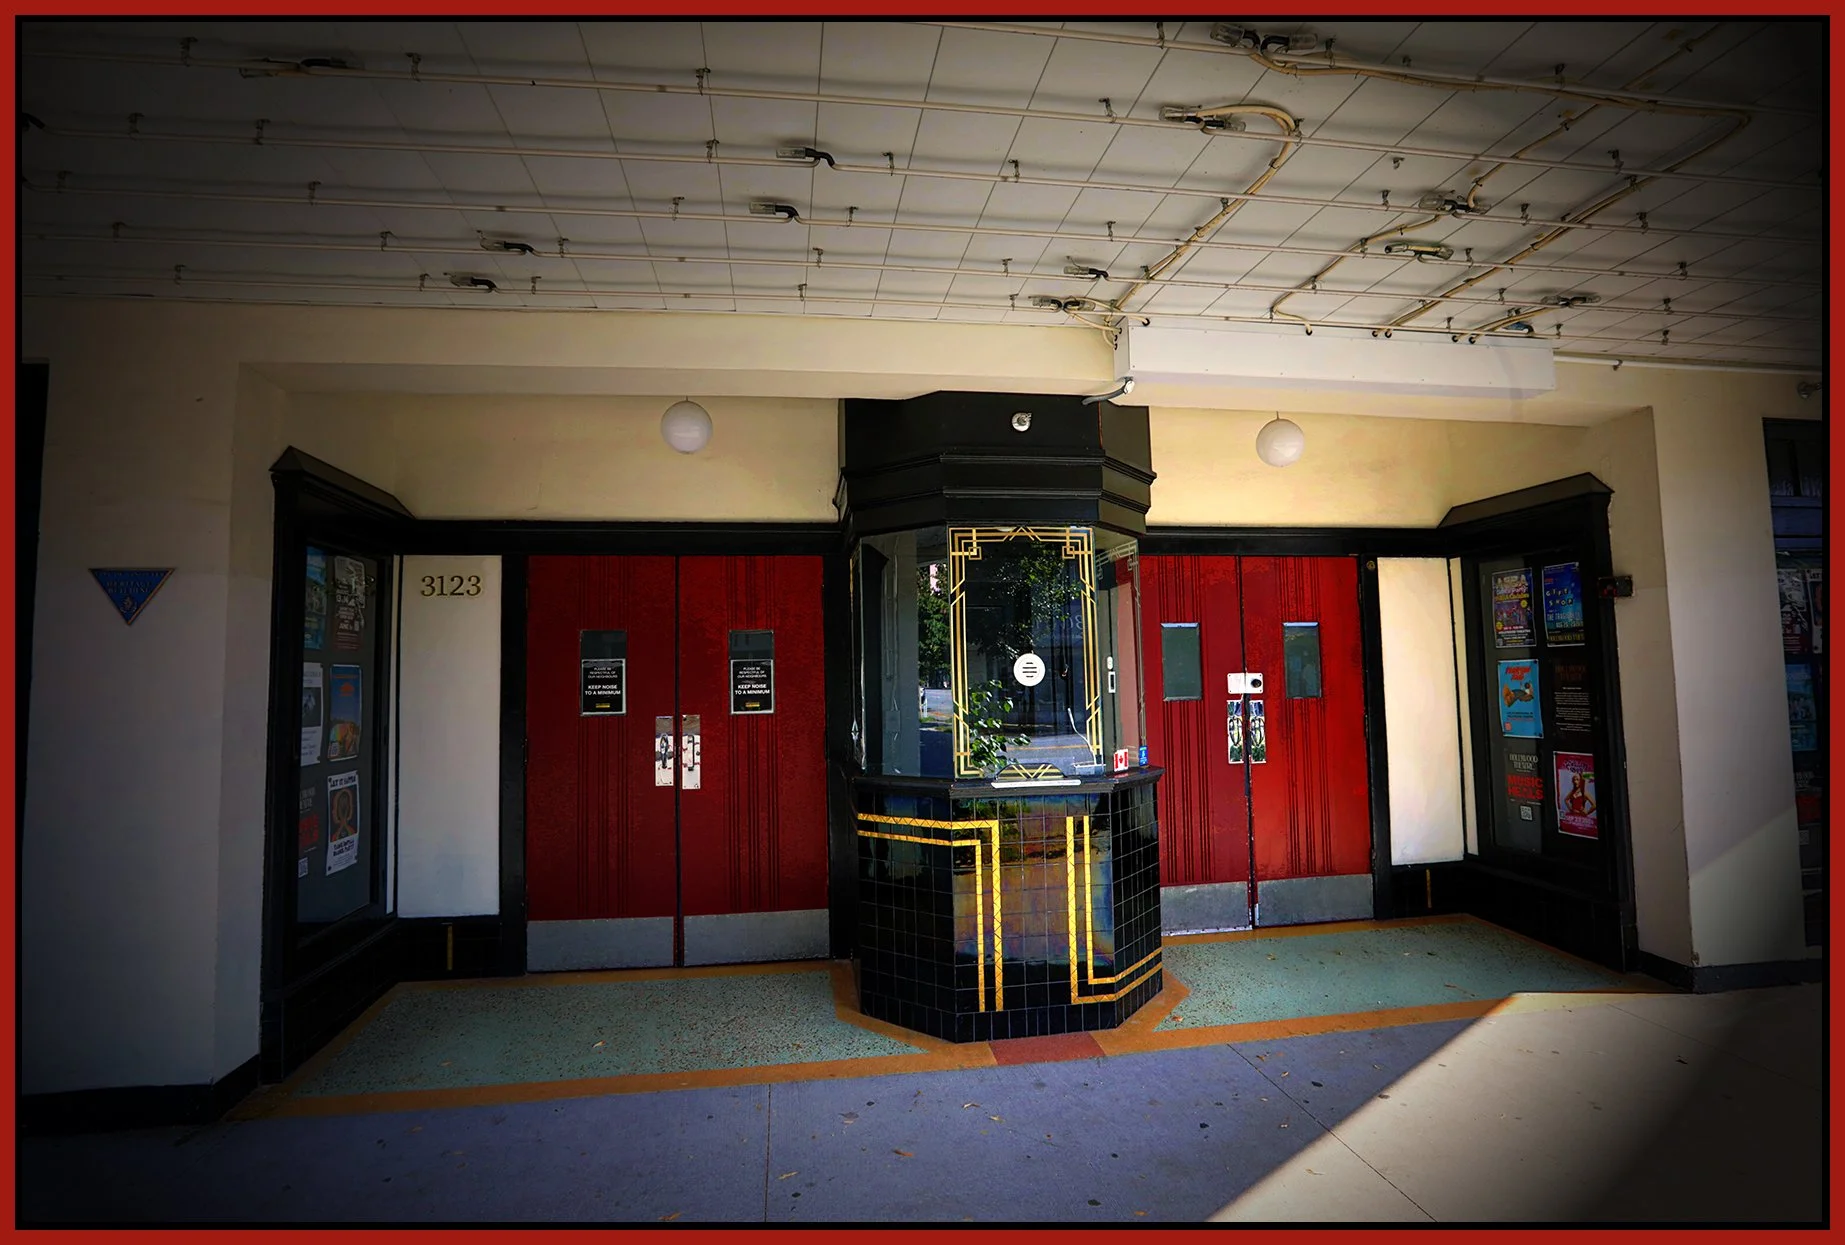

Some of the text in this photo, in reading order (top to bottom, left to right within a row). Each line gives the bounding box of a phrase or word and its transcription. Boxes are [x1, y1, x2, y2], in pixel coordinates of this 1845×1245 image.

[421, 575, 481, 596] 3123
[1507, 775, 1544, 788] MUSIC
[1507, 786, 1545, 801] HEALS
